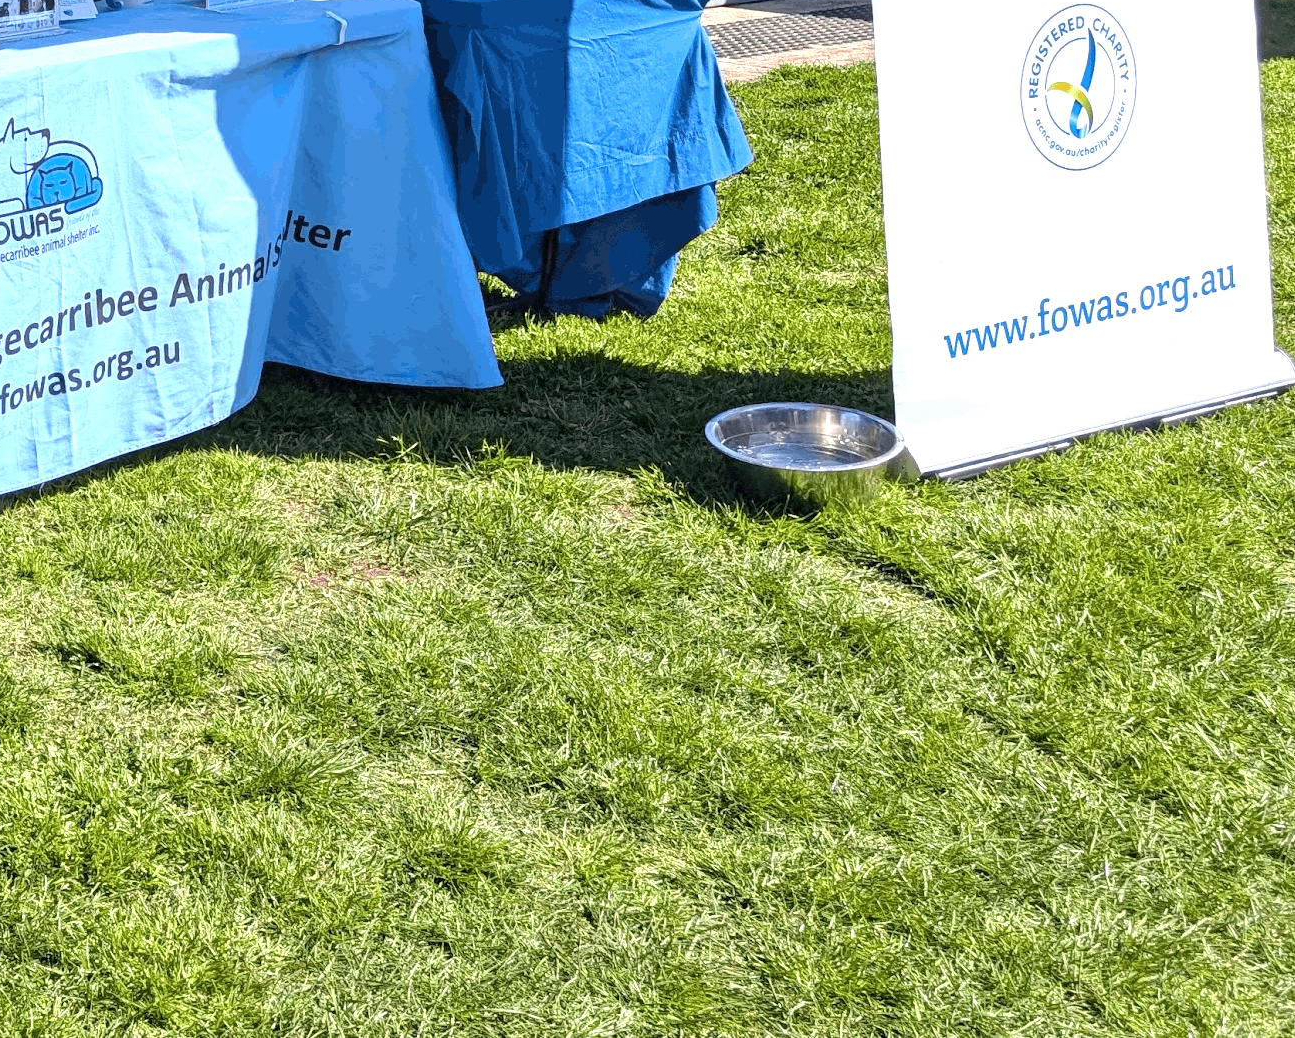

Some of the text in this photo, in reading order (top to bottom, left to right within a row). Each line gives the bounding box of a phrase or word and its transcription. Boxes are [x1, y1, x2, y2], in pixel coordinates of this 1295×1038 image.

[1029, 16, 1129, 99] REGISTERED CHARITY
[41, 234, 66, 254] animal
[67, 228, 89, 246] shelter
[169, 241, 272, 308] Animal
[943, 265, 1236, 359] www.fowas.org.au
